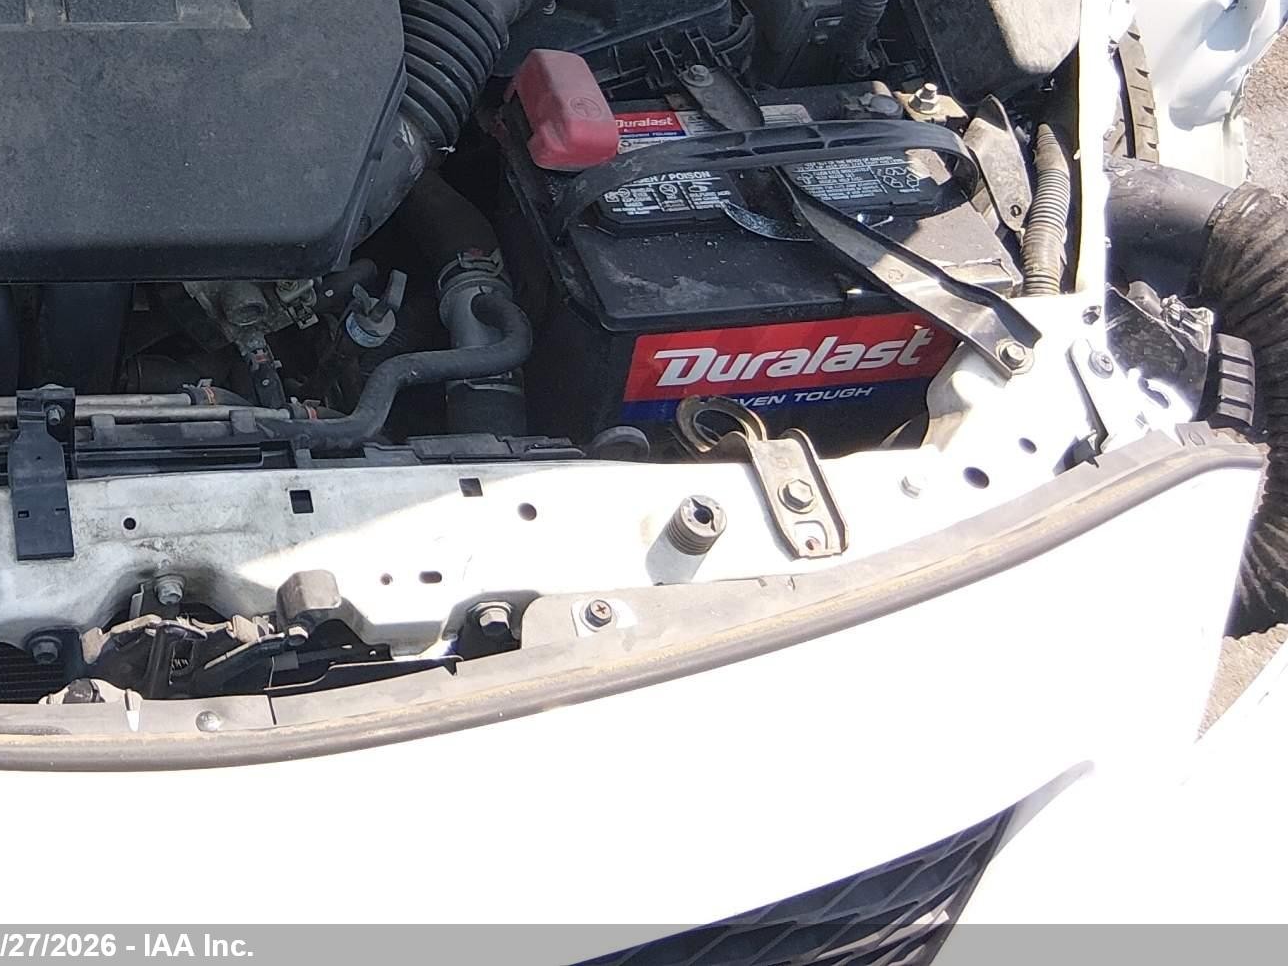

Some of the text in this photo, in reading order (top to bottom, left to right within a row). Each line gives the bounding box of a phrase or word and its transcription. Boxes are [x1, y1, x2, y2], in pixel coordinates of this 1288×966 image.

[669, 170, 711, 181] POISON
[654, 326, 934, 387] Duralast
[793, 386, 875, 404] TOUGH
